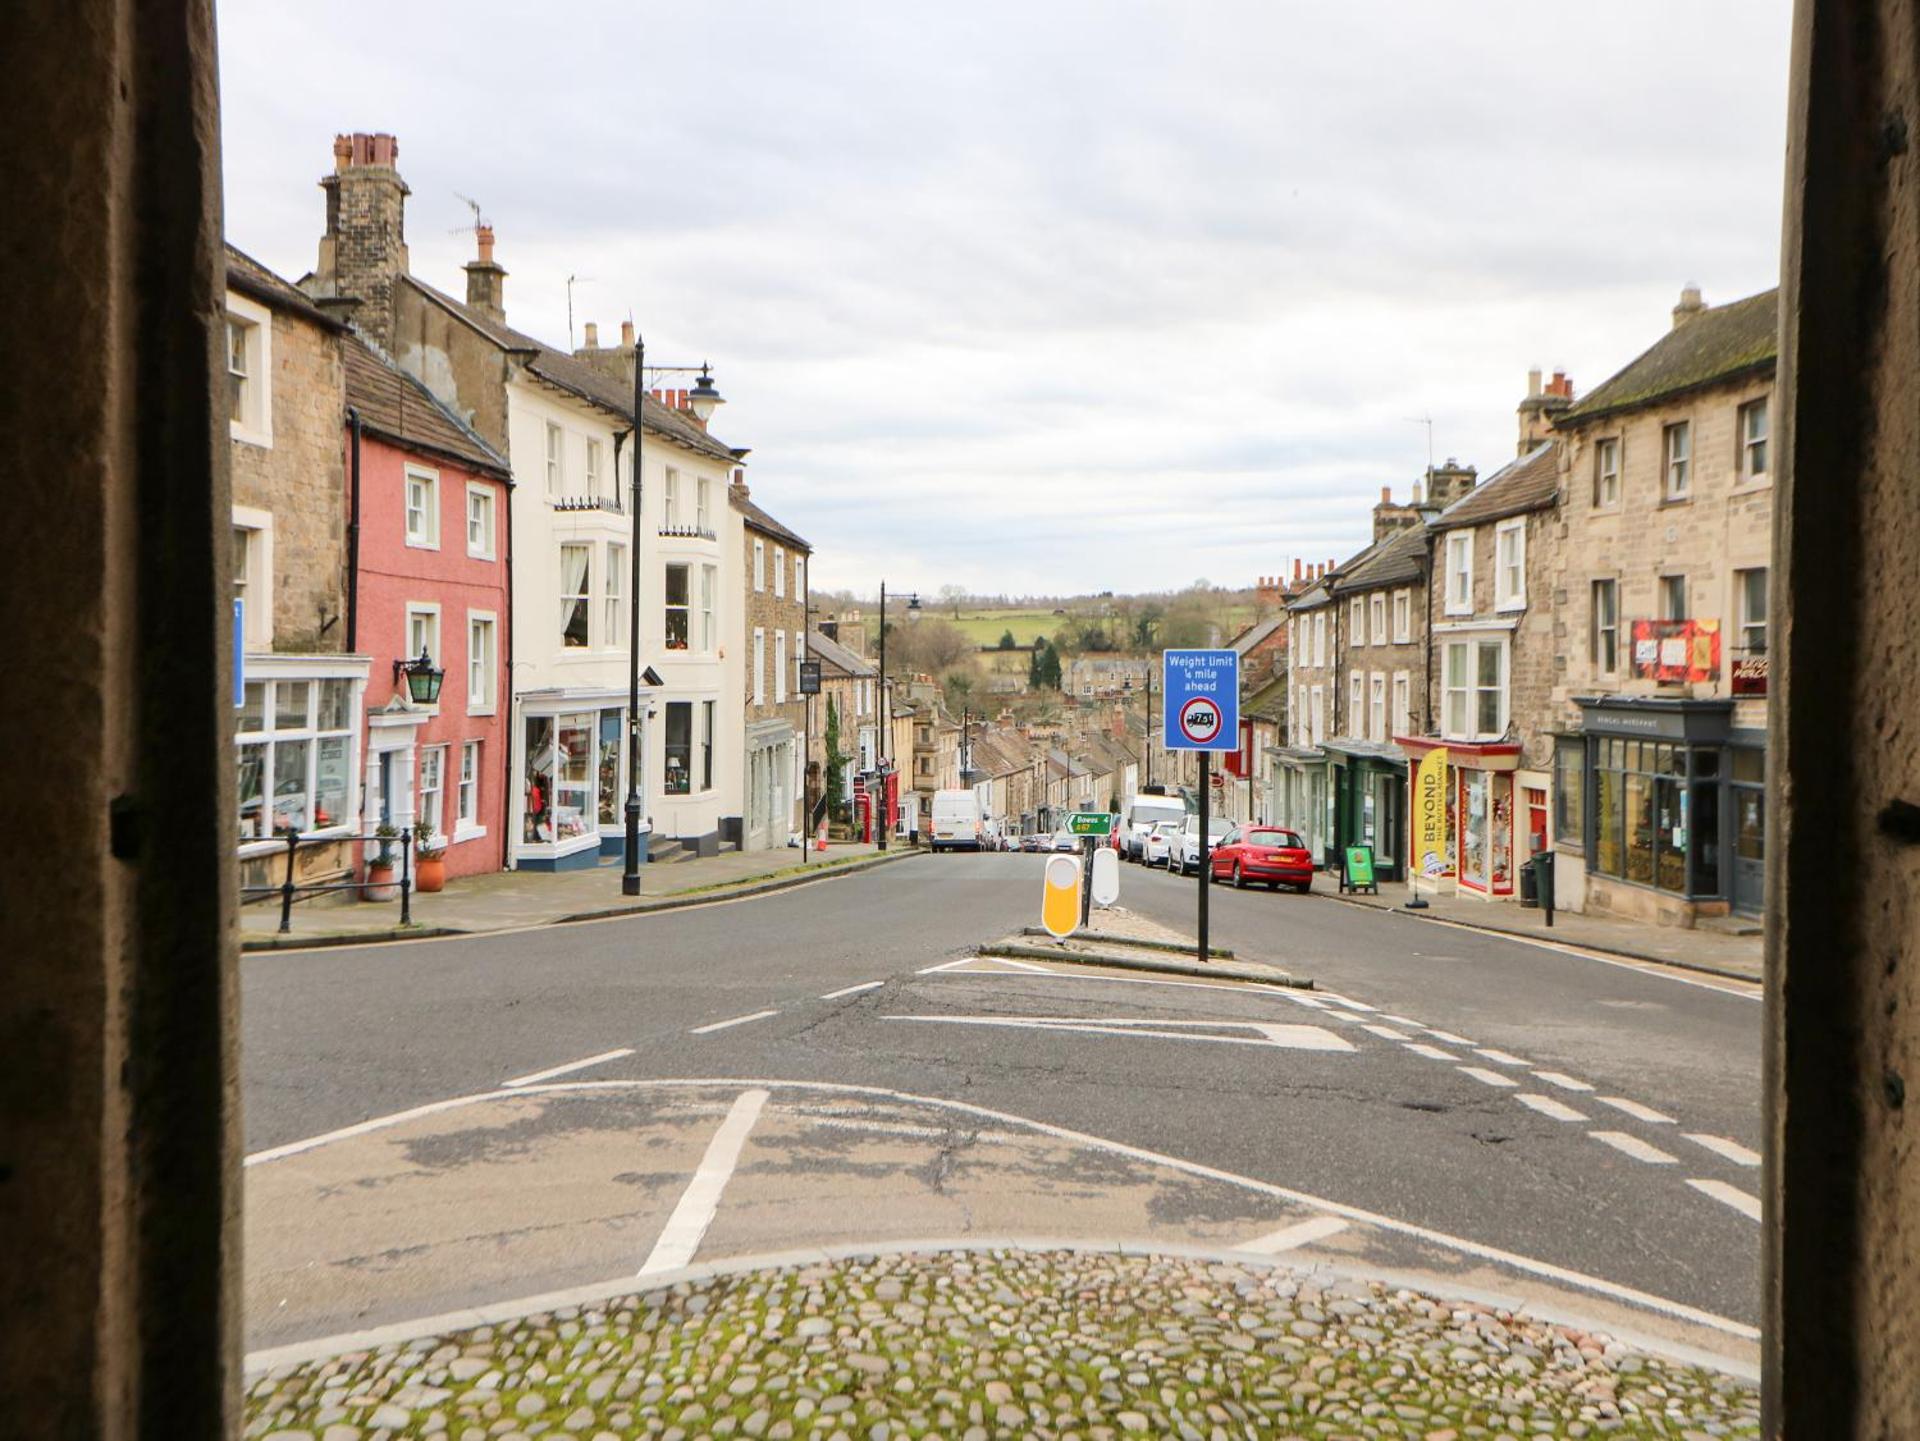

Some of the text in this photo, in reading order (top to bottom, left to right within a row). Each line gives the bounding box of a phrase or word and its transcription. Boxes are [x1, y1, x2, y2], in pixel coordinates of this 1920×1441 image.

[1169, 656, 1206, 669] Weight
[1194, 669, 1217, 679] mile
[1184, 682, 1217, 691] ahead
[1424, 774, 1436, 842] BEYOND
